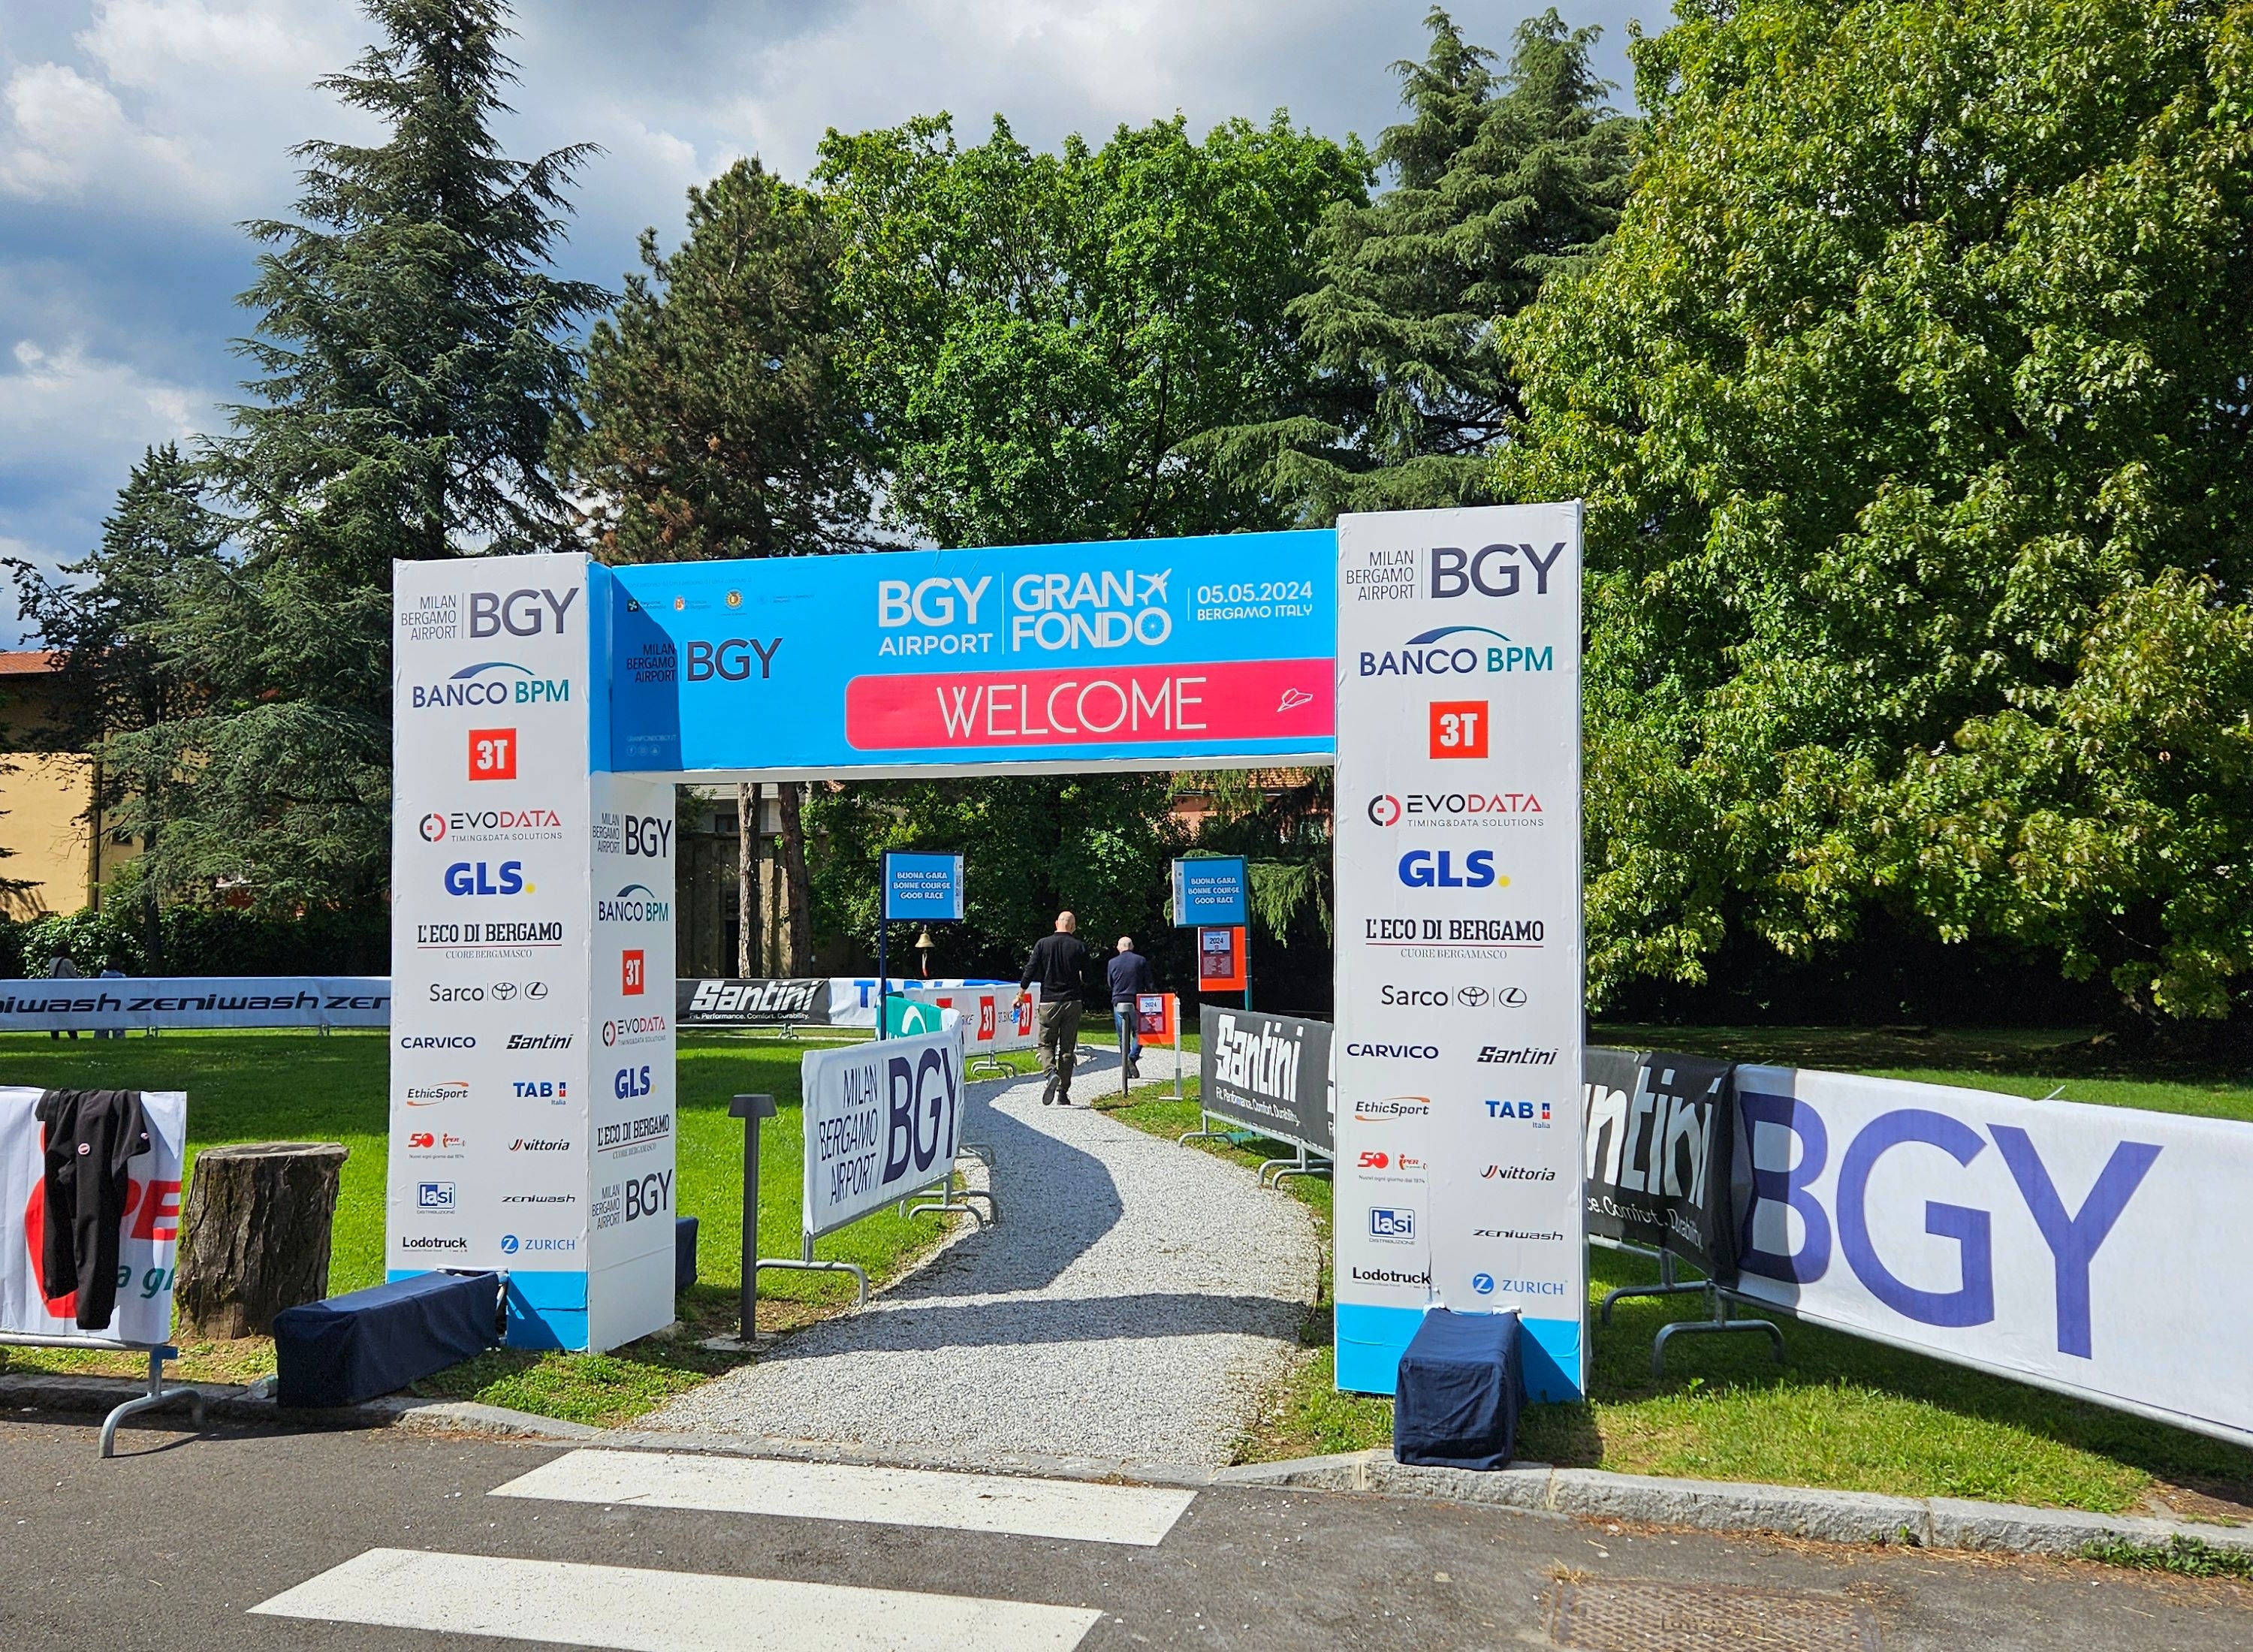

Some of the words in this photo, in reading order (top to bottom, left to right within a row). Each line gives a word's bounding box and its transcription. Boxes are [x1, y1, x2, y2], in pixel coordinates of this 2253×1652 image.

[1370, 550, 1413, 566] MILAN
[1347, 568, 1413, 584] BERGAMO
[1431, 542, 1567, 598] BGY
[1012, 569, 1134, 610] GRAN
[1197, 581, 1313, 604] 05.05.2024
[1358, 584, 1415, 601] AIRPORT
[420, 595, 456, 609] MILAN
[879, 576, 992, 627] BGY
[401, 611, 457, 626] BERGAMO
[469, 587, 580, 638] BGY
[1197, 607, 1271, 621] BERGAMO
[1275, 604, 1313, 617] ITALY
[410, 626, 457, 641] AIRPORT
[1012, 607, 1172, 652] FONDO
[643, 644, 675, 656] MILAN
[879, 633, 993, 656] AIRPORT
[627, 656, 675, 670] BERGAMO
[687, 638, 783, 682] BGY
[1360, 648, 1477, 676] BANCO
[1487, 647, 1552, 672] BPM
[635, 670, 676, 683] AIRPORT
[413, 681, 508, 708] BANCO
[515, 680, 569, 704] BPM
[936, 677, 1207, 738] WELCOME
[1440, 713, 1478, 746] 3T
[477, 740, 508, 770] 3T
[1407, 794, 1543, 813] EVODATA
[451, 809, 562, 830] EVODATA
[602, 812, 620, 826] MILAN
[1482, 818, 1544, 827] SOLUTIONS
[451, 834, 509, 843] TIMING&DATA
[512, 832, 562, 841] SOLUTIONS
[592, 825, 620, 840] BERGAMO
[625, 815, 672, 858] BGY
[597, 840, 620, 853] AIRPORT
[599, 901, 644, 921] BANCO
[646, 902, 668, 921] BPM
[418, 923, 460, 943] L'ECO
[463, 923, 480, 942] DI
[485, 922, 562, 942] BERGAMO
[1365, 919, 1416, 940] L'ECO
[1422, 920, 1442, 940] DI
[1449, 920, 1544, 942] BERGAMO
[445, 950, 475, 959] CUORE
[476, 949, 532, 959] BERGAMASCO
[1401, 948, 1435, 958] CUORE
[1437, 949, 1507, 960] BERGAMASCO
[626, 960, 640, 986] 3T
[0, 993, 122, 1013] iwash
[126, 990, 319, 1011] zeniwash
[430, 983, 484, 1002] Sarco
[689, 980, 819, 1011] Santini
[1381, 984, 1449, 1006] Sarco
[617, 1017, 665, 1035] EVODATA
[983, 1005, 993, 1031] 3T
[401, 1036, 476, 1049] CARVICO
[506, 1034, 574, 1049] Santini
[1215, 1014, 1304, 1102] Santini
[1347, 1043, 1439, 1060] CARVICO
[1476, 1046, 1559, 1065] Santini
[407, 1088, 468, 1100] EthicSport
[513, 1082, 553, 1097] TAB
[843, 1064, 878, 1108] MILAN
[882, 1044, 960, 1185] BGY
[1355, 1100, 1429, 1117] EthicSport
[1485, 1100, 1534, 1119] TAB
[598, 1124, 620, 1147] L'ECO
[623, 1123, 632, 1140] DI
[633, 1114, 669, 1138] BERGAMO
[819, 1108, 878, 1161] BERGAMO
[1585, 1066, 1721, 1210] ntini
[408, 1133, 434, 1148] 50
[523, 1139, 570, 1151] vittoria
[1357, 1151, 1389, 1168] 50
[830, 1153, 876, 1206] AIRPORT
[1499, 1167, 1555, 1182] vittoria
[502, 1195, 576, 1203] zeniwash
[602, 1183, 620, 1198] MILAN
[626, 1168, 673, 1222] BGY
[592, 1198, 620, 1216] BERGAMO
[597, 1212, 620, 1231] AIRPORT
[1738, 1091, 2164, 1361] BGY
[403, 1237, 467, 1248] Lodotruck
[525, 1239, 575, 1250] ZURICH
[1473, 1229, 1564, 1241] zeniwash
[1353, 1267, 1431, 1285] Lodotruck
[1503, 1280, 1564, 1295] ZURICH
